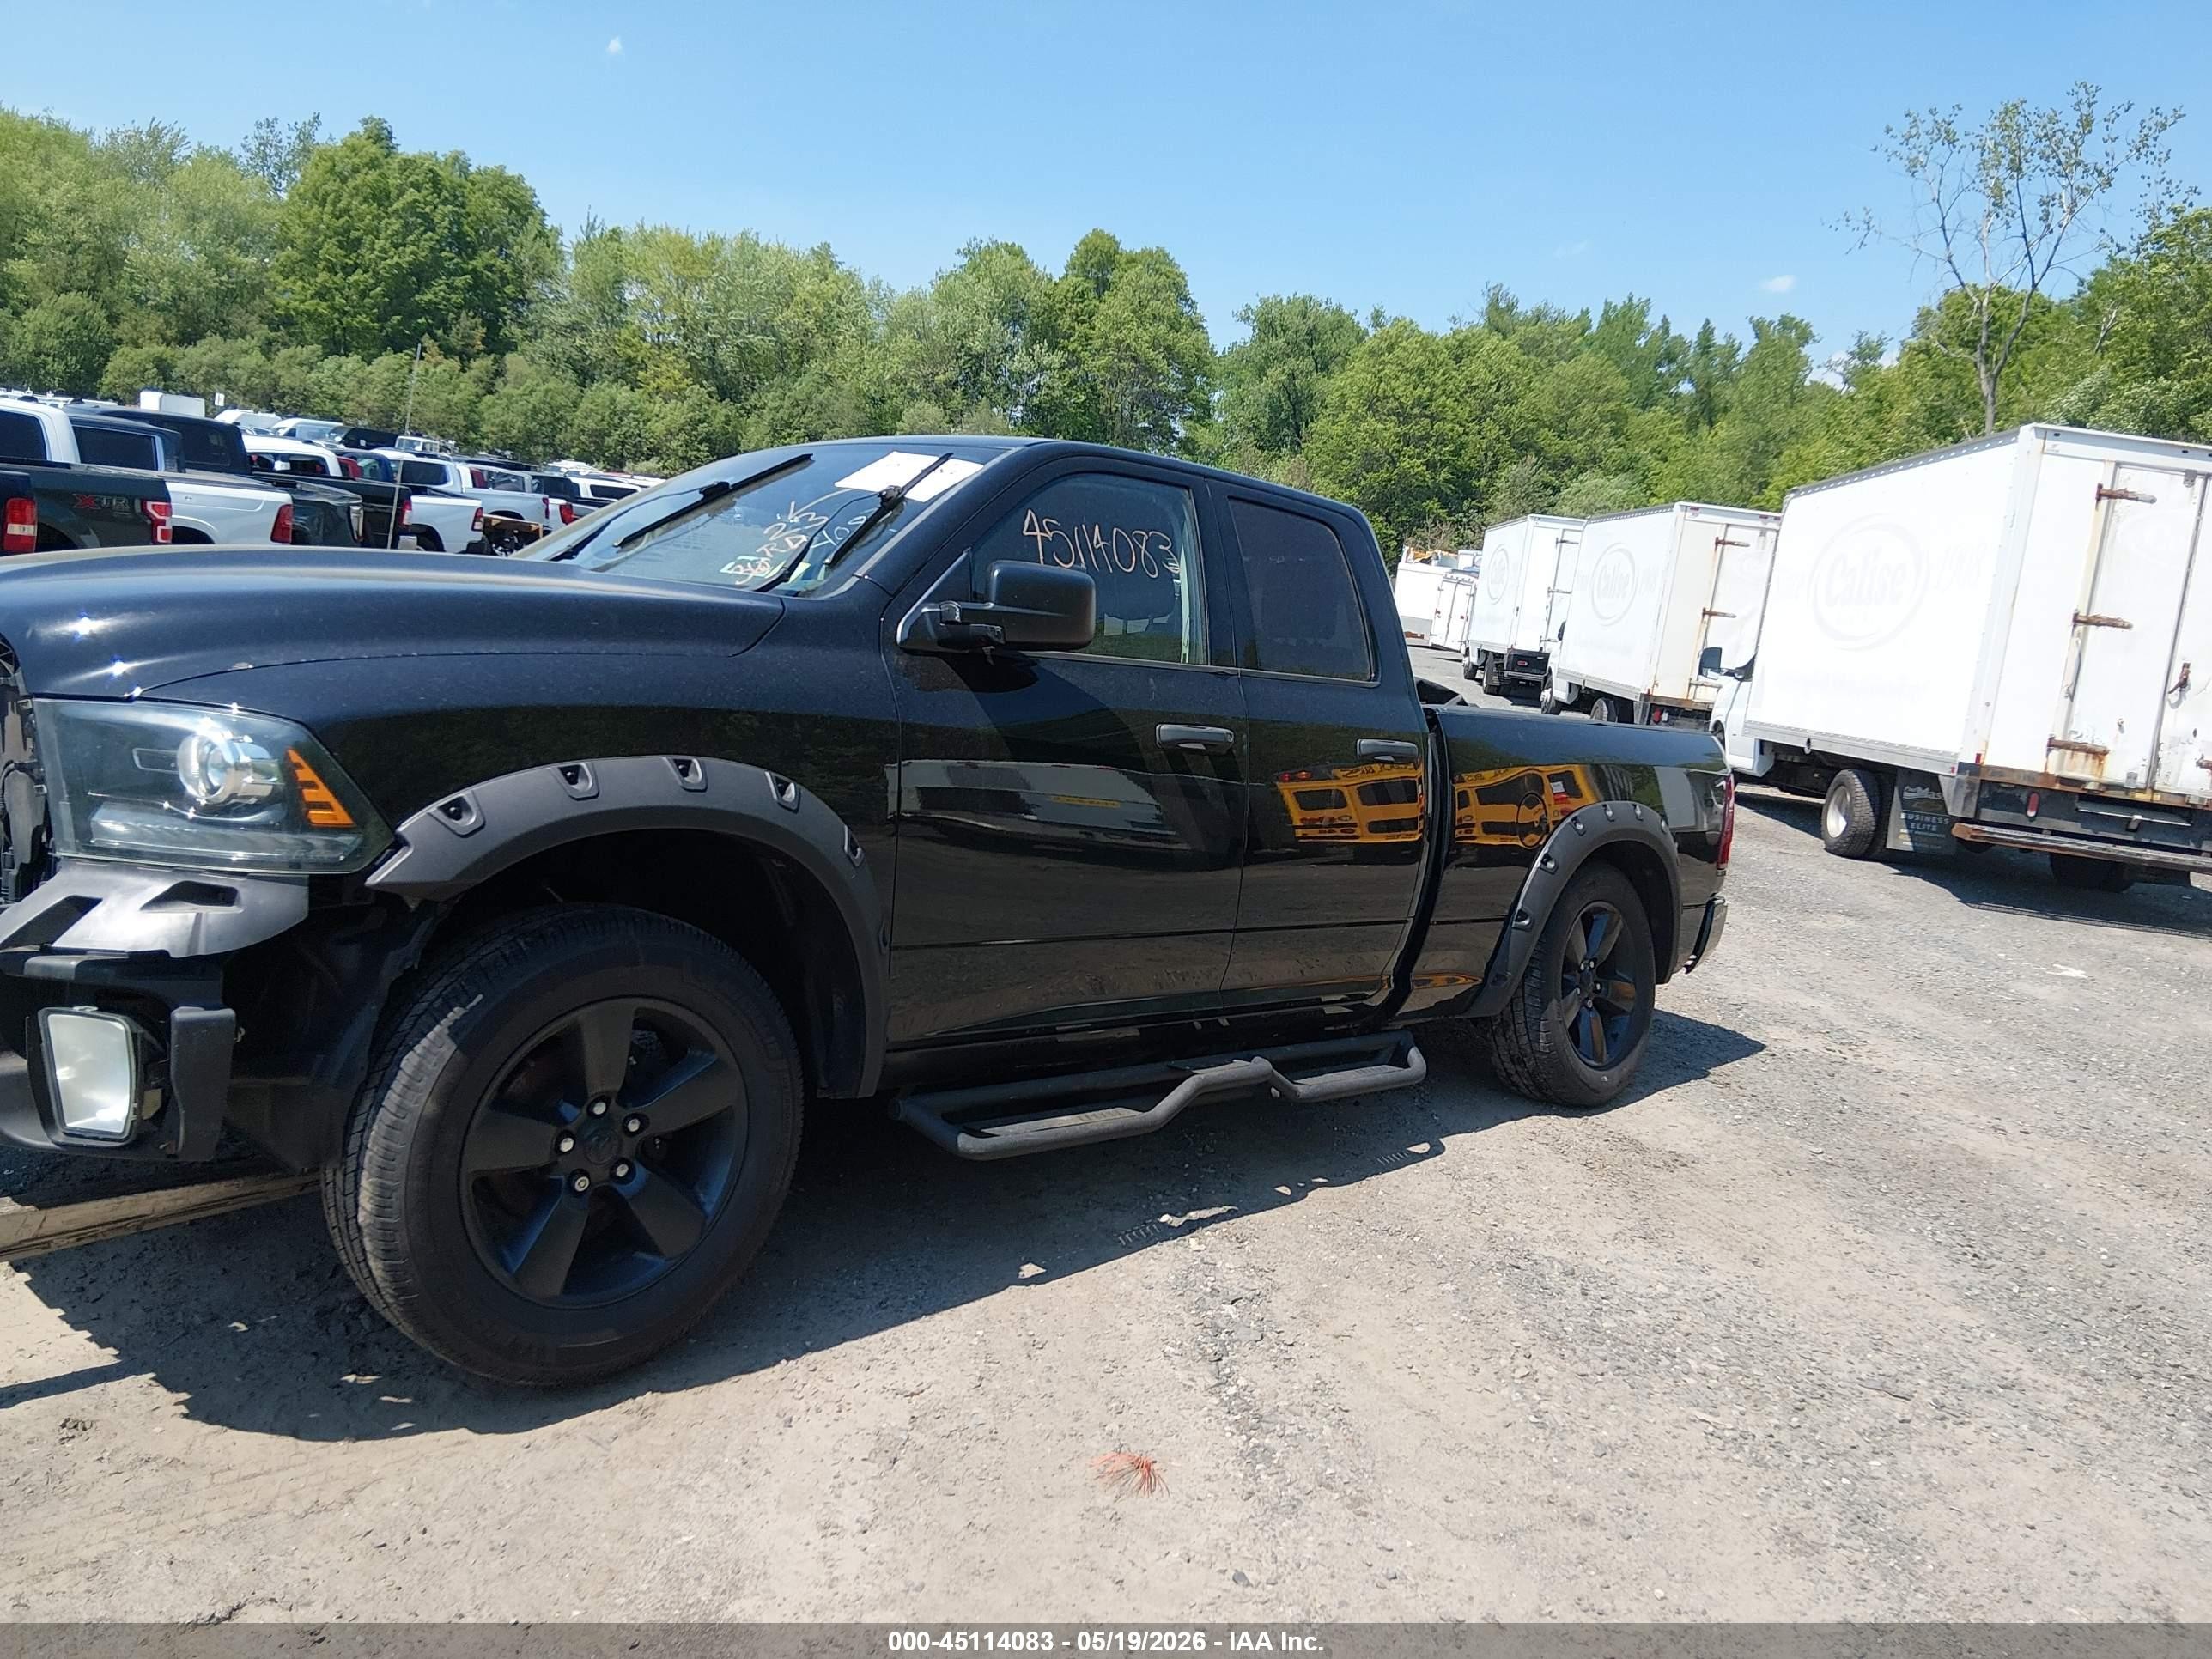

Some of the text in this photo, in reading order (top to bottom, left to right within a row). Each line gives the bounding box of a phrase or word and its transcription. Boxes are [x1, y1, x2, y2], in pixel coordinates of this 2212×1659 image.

[72, 493, 131, 511] XTR
[1022, 508, 1180, 579] 45114083
[1900, 813, 1950, 823] BUSINESS
[1911, 822, 1937, 830] ELITE
